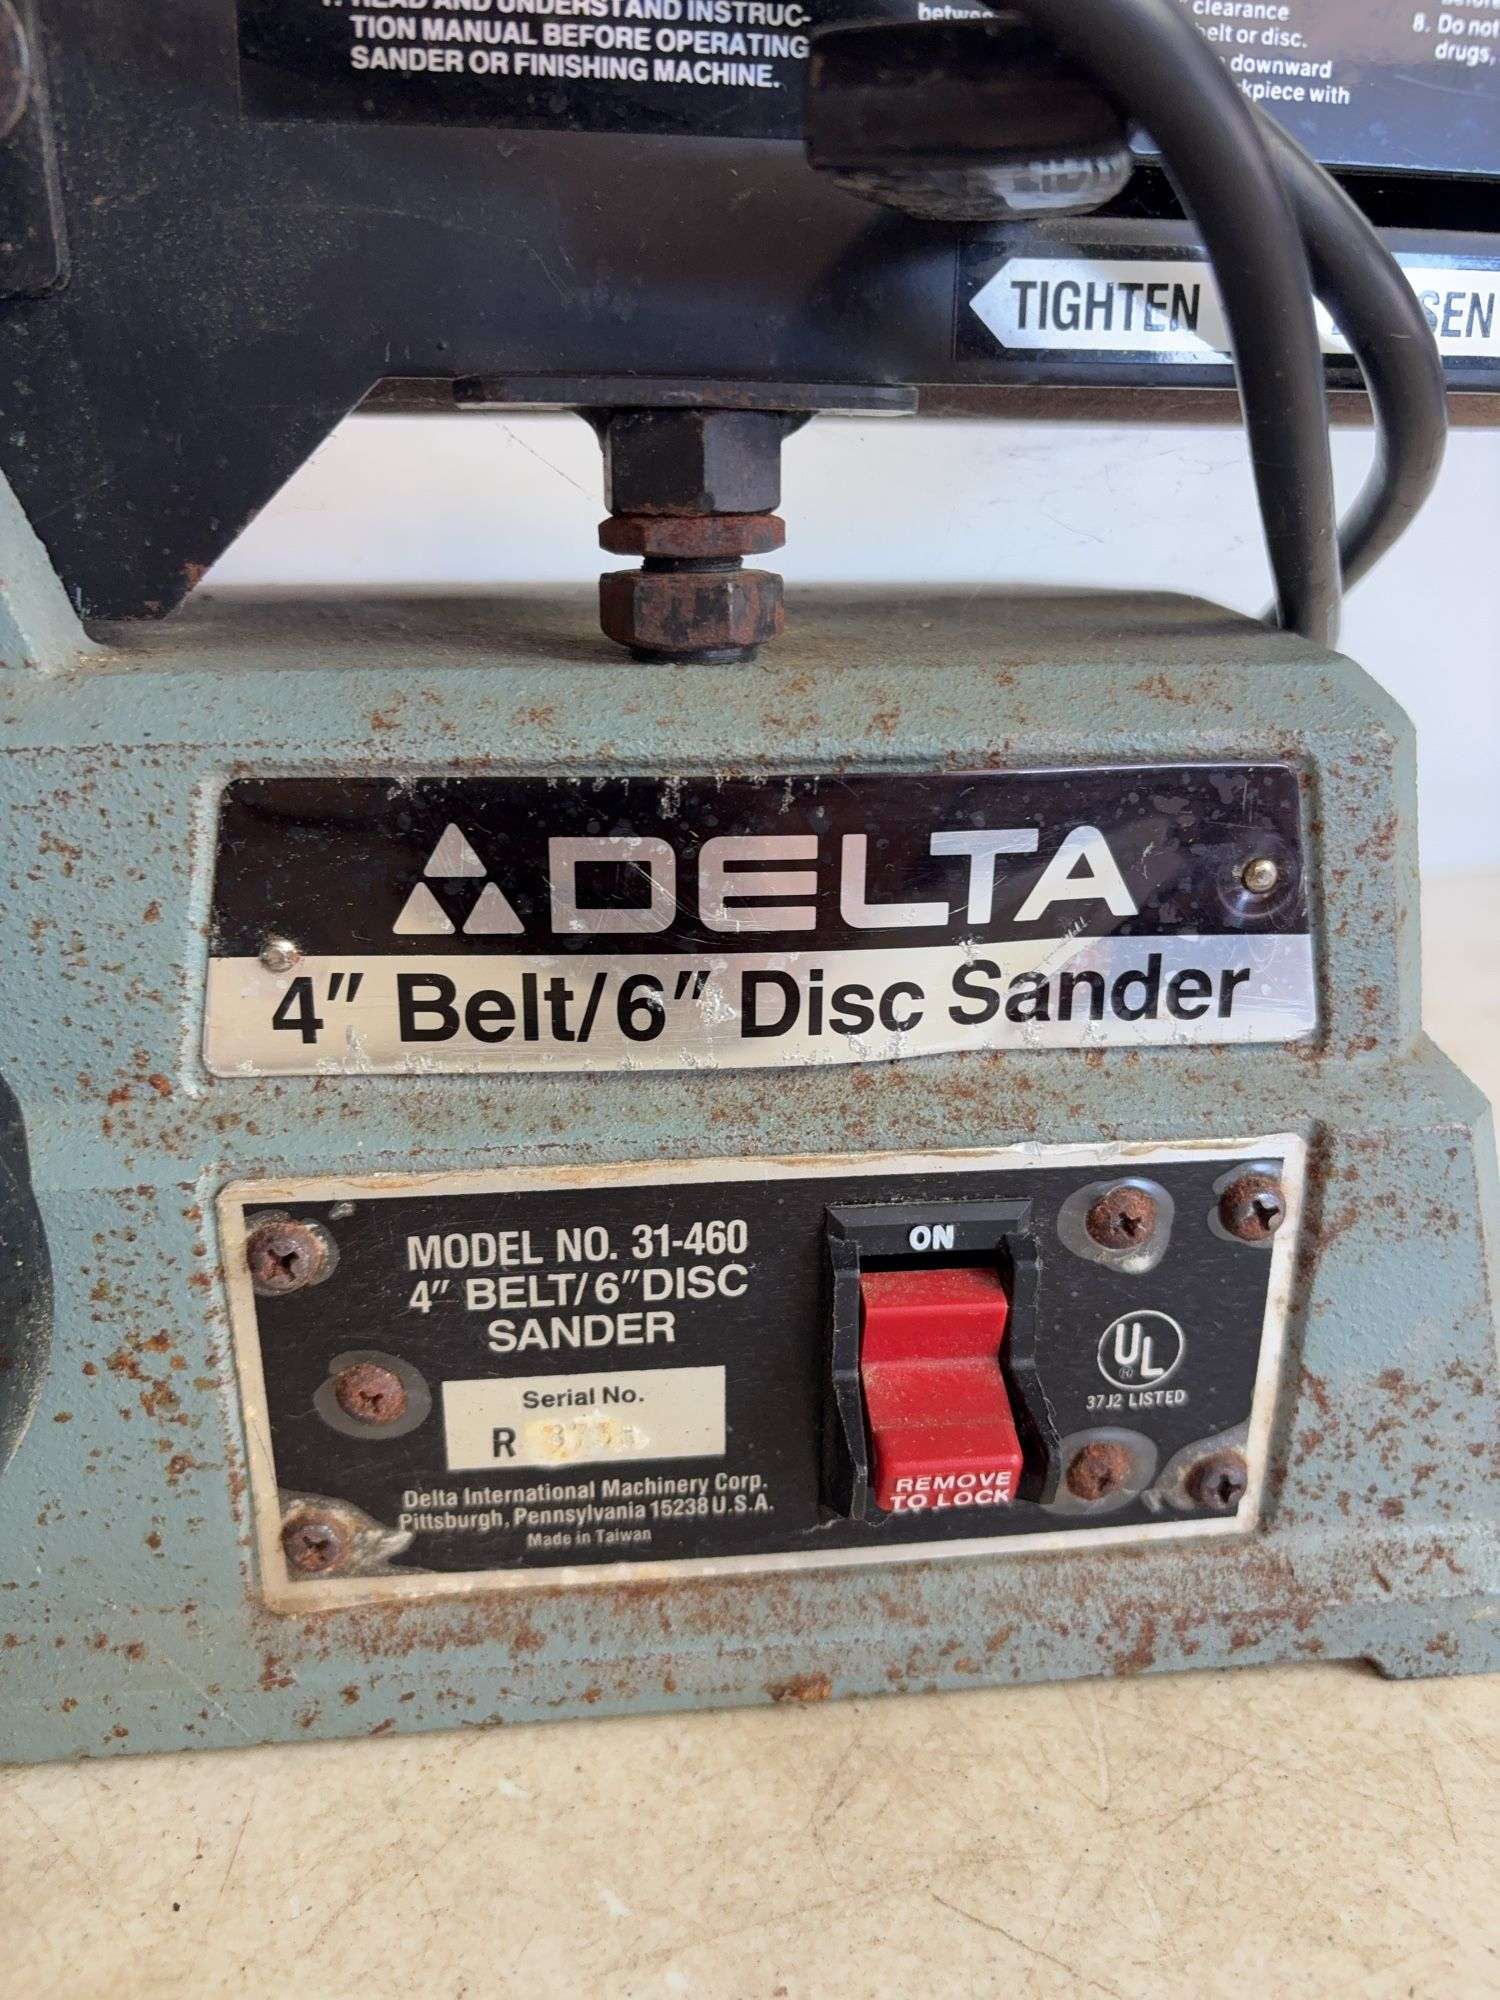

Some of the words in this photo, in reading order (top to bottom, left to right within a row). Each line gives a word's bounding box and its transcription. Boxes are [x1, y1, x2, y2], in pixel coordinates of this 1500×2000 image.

[497, 0, 683, 22] UNDERSTAND
[687, 0, 812, 27] INSTRUC-
[1193, 0, 1290, 21] clearance
[349, 15, 417, 40] TION
[421, 17, 538, 45] MANUAL
[543, 23, 651, 51] BEFORE
[655, 28, 811, 59] OPERATING
[1236, 28, 1259, 44] or
[1261, 27, 1308, 48] disc.
[1438, 13, 1465, 35] Do
[1468, 18, 1500, 38] not
[351, 45, 464, 73] SANDER
[468, 50, 509, 75] OR
[514, 52, 648, 81] FINISHING
[653, 59, 781, 88] MACHINE.
[1230, 53, 1333, 79] downward
[1434, 38, 1497, 67] drugs,
[1309, 86, 1350, 105] with
[1010, 280, 1201, 333] TIGHTEN
[549, 824, 1139, 933] DELTA
[272, 972, 364, 1044] 4"
[741, 968, 925, 1038] Disc
[948, 953, 1250, 1026] Sander
[407, 1229, 544, 1270] MODEL
[556, 1226, 619, 1262] NO.
[632, 1218, 748, 1259] 31-460
[909, 1225, 955, 1251] ON
[409, 1279, 449, 1314] 4"
[488, 1311, 676, 1352] SANDER
[1114, 1322, 1164, 1376] UL
[522, 1386, 595, 1409] Serial
[602, 1385, 645, 1404] No.
[1129, 1389, 1186, 1407] LISTED
[492, 1426, 517, 1458] R
[403, 1489, 458, 1508] Delta
[463, 1480, 596, 1506] International
[602, 1476, 709, 1499] Machinery
[715, 1472, 768, 1493] Corp.
[896, 1471, 1012, 1493] REMOVE
[399, 1509, 511, 1534] Pittsburgh,
[513, 1501, 646, 1526] Pennsylvania
[649, 1496, 709, 1520] 15238
[712, 1493, 775, 1516] U.S.A.
[890, 1492, 928, 1513] TO
[936, 1488, 1009, 1508] LOCK
[526, 1531, 571, 1549] Made
[575, 1530, 591, 1545] in
[595, 1528, 652, 1545] Taiwan
